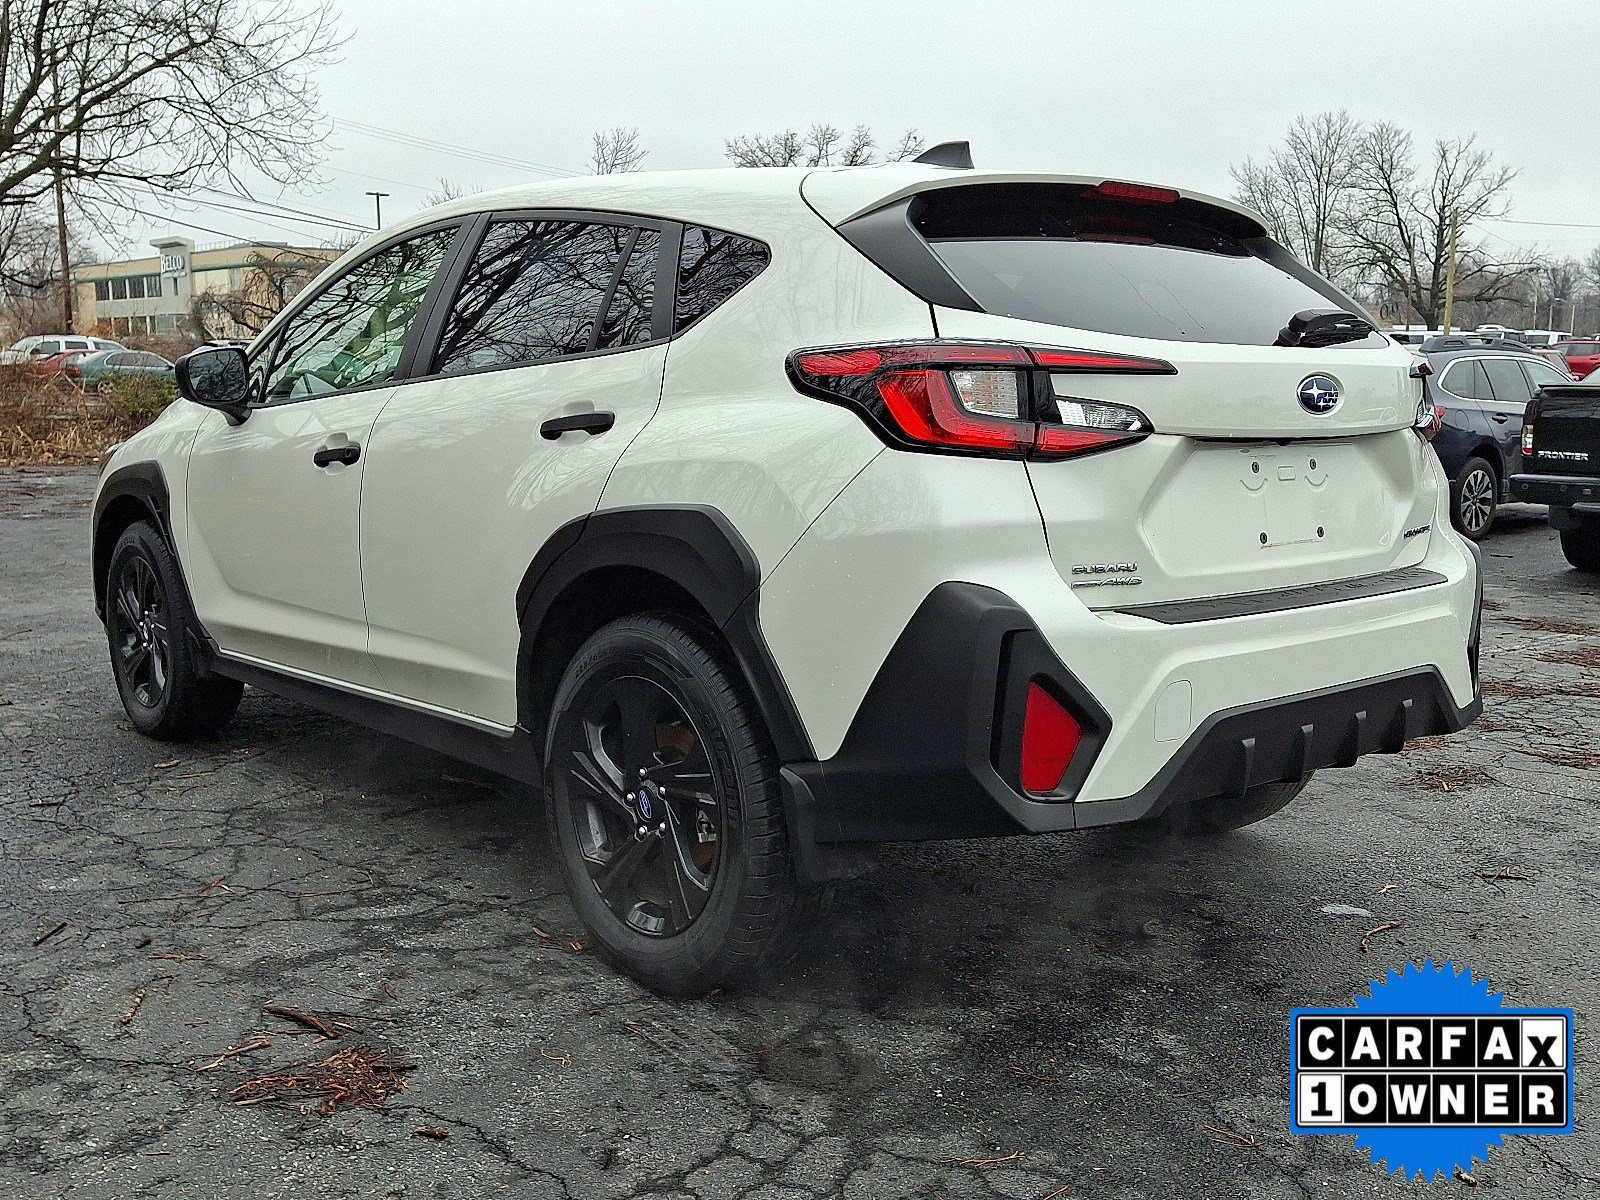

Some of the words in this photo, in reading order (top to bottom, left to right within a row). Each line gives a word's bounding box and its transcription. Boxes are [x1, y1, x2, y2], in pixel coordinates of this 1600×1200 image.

[1537, 450, 1589, 461] FRONTIER
[1072, 562, 1138, 575] SUBARU
[1100, 576, 1143, 587] AWD
